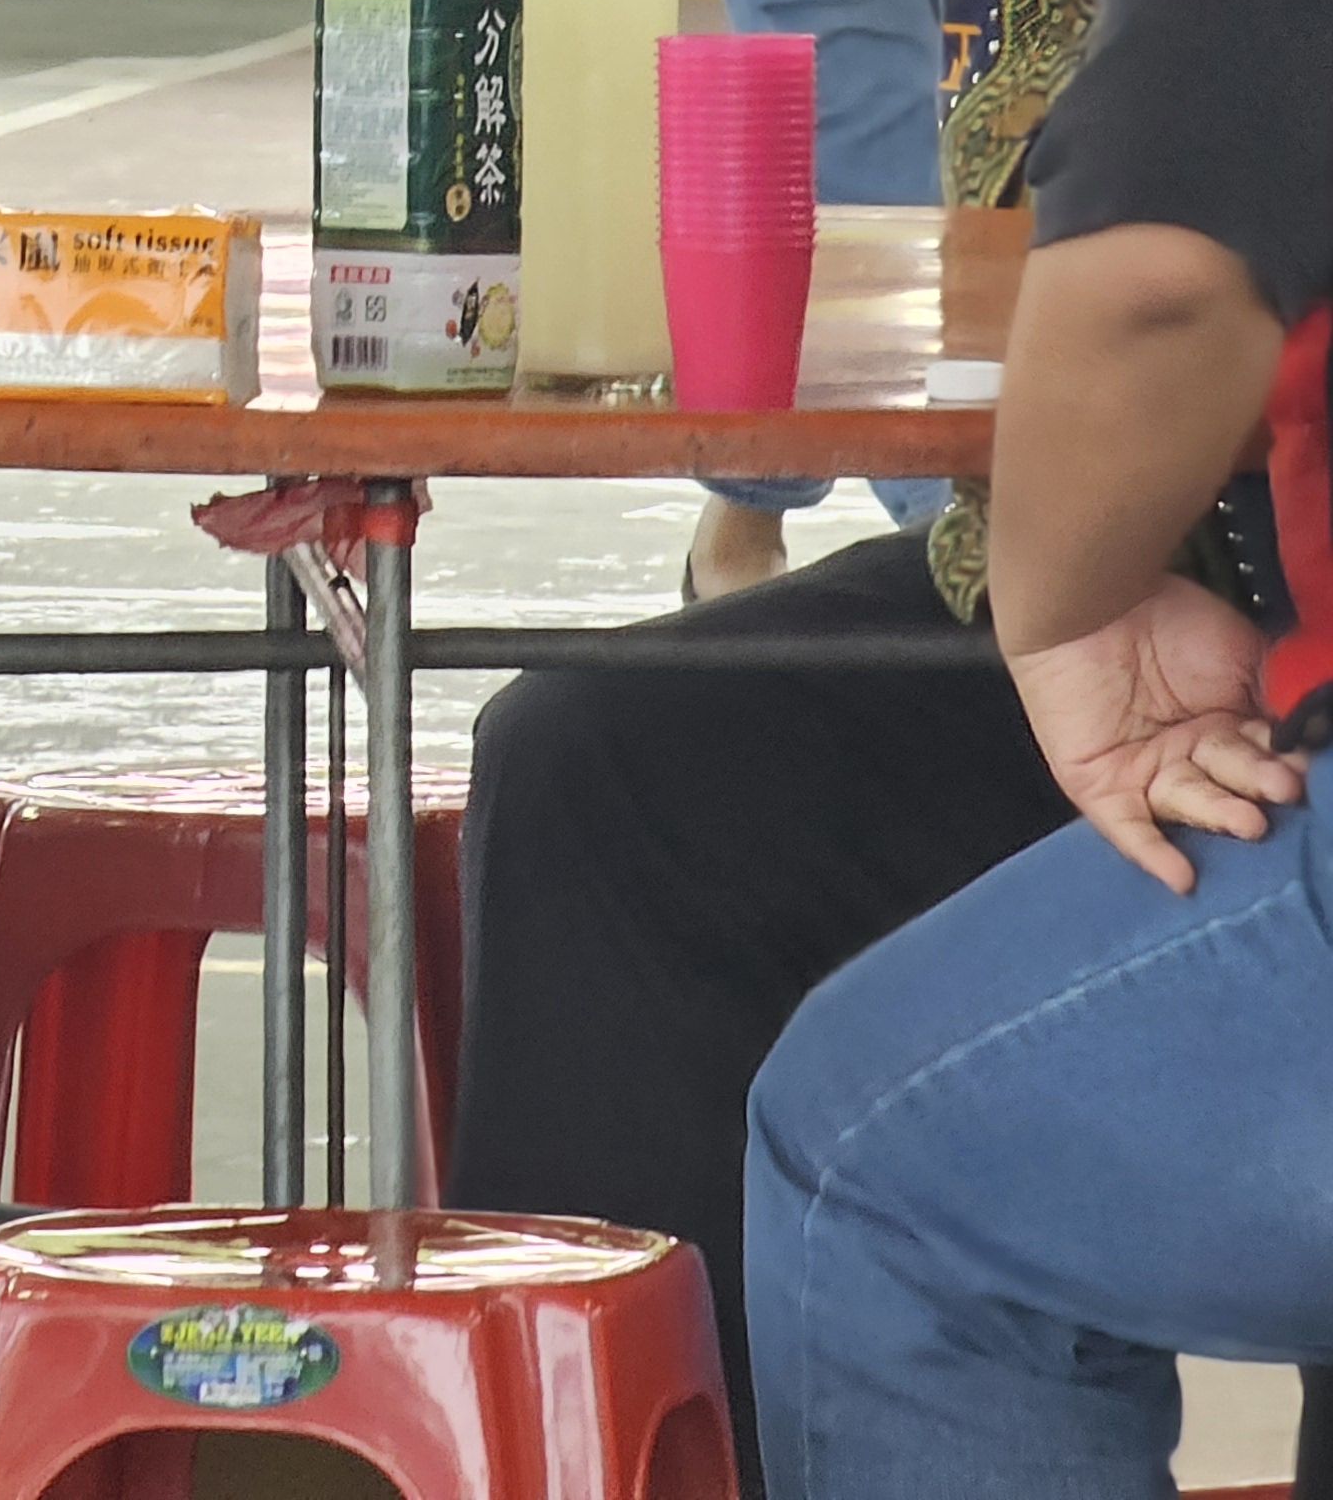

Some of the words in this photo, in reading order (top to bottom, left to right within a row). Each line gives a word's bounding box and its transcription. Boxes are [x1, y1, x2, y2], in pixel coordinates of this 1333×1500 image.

[474, 8, 507, 205] 分解茶
[73, 223, 124, 251] soft
[135, 228, 217, 255] tissue
